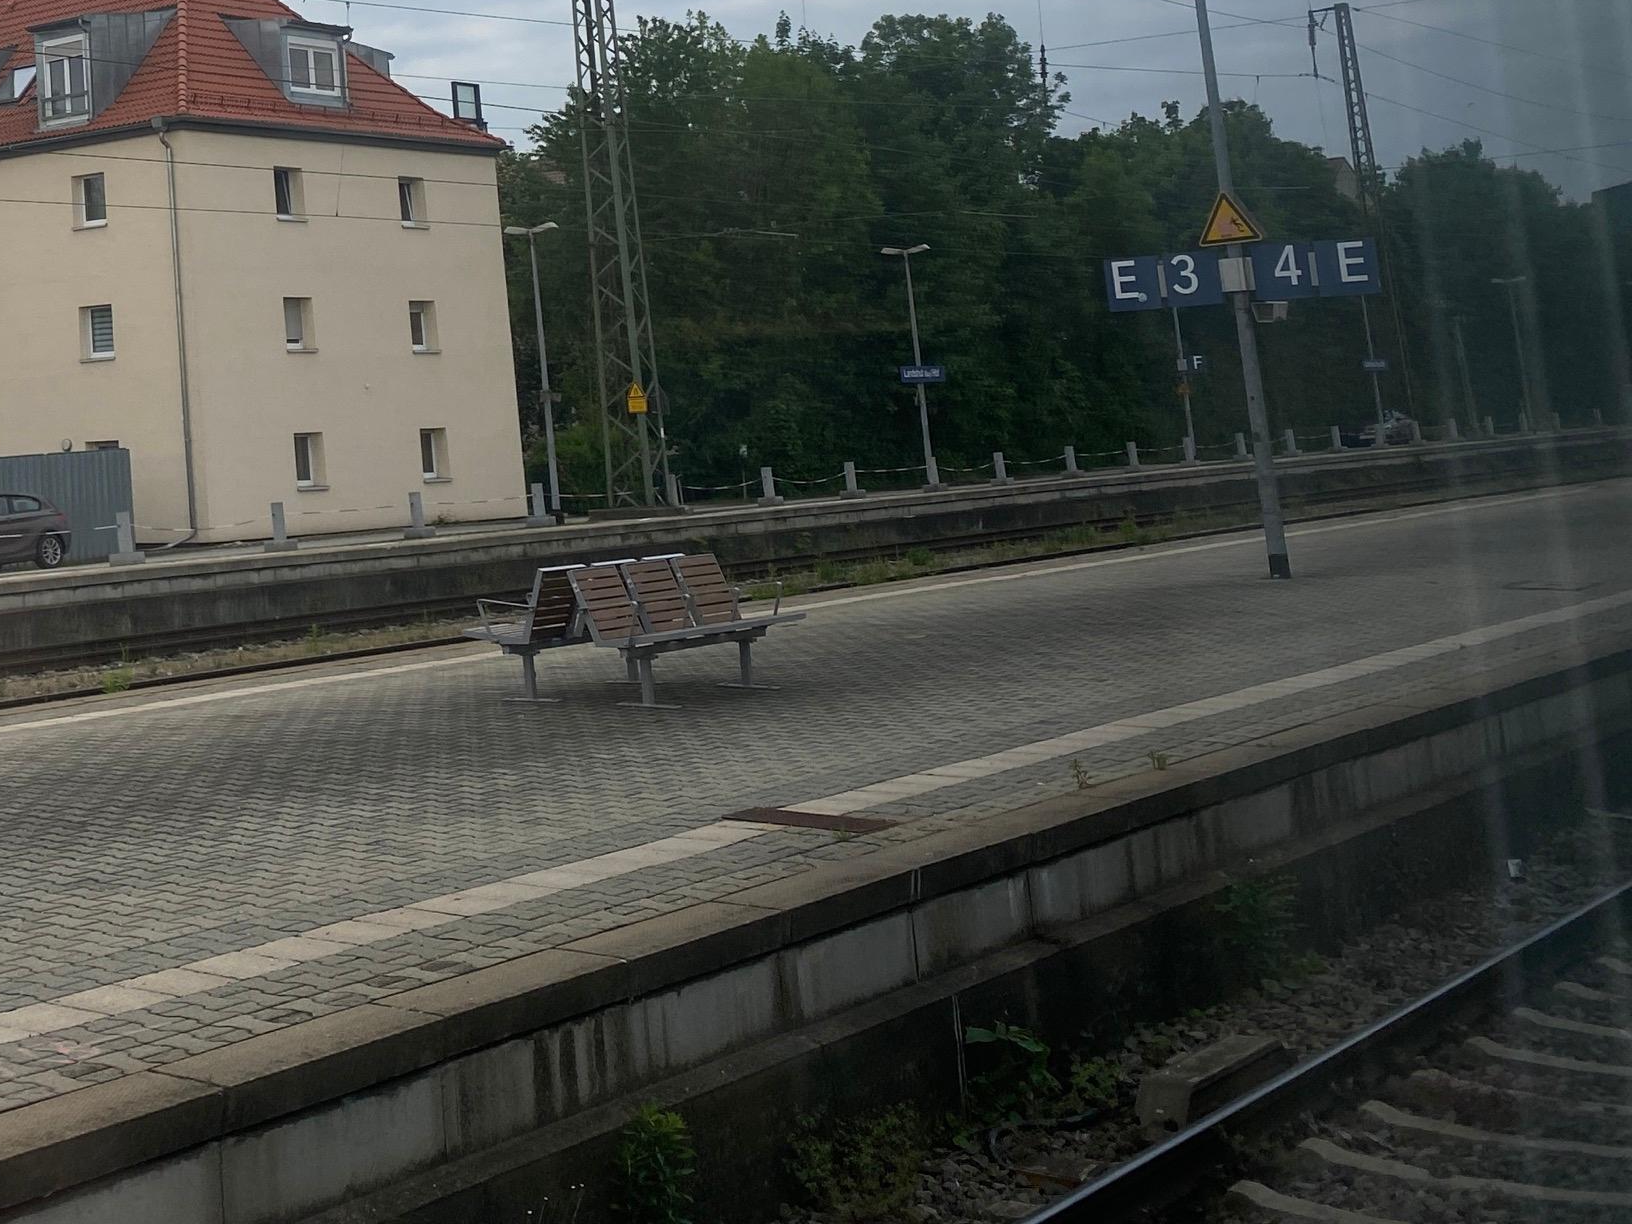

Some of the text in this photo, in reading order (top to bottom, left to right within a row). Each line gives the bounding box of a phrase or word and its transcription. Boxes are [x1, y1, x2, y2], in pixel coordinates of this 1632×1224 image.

[1110, 241, 1369, 300] E 3 4 E
[1193, 355, 1203, 370] F
